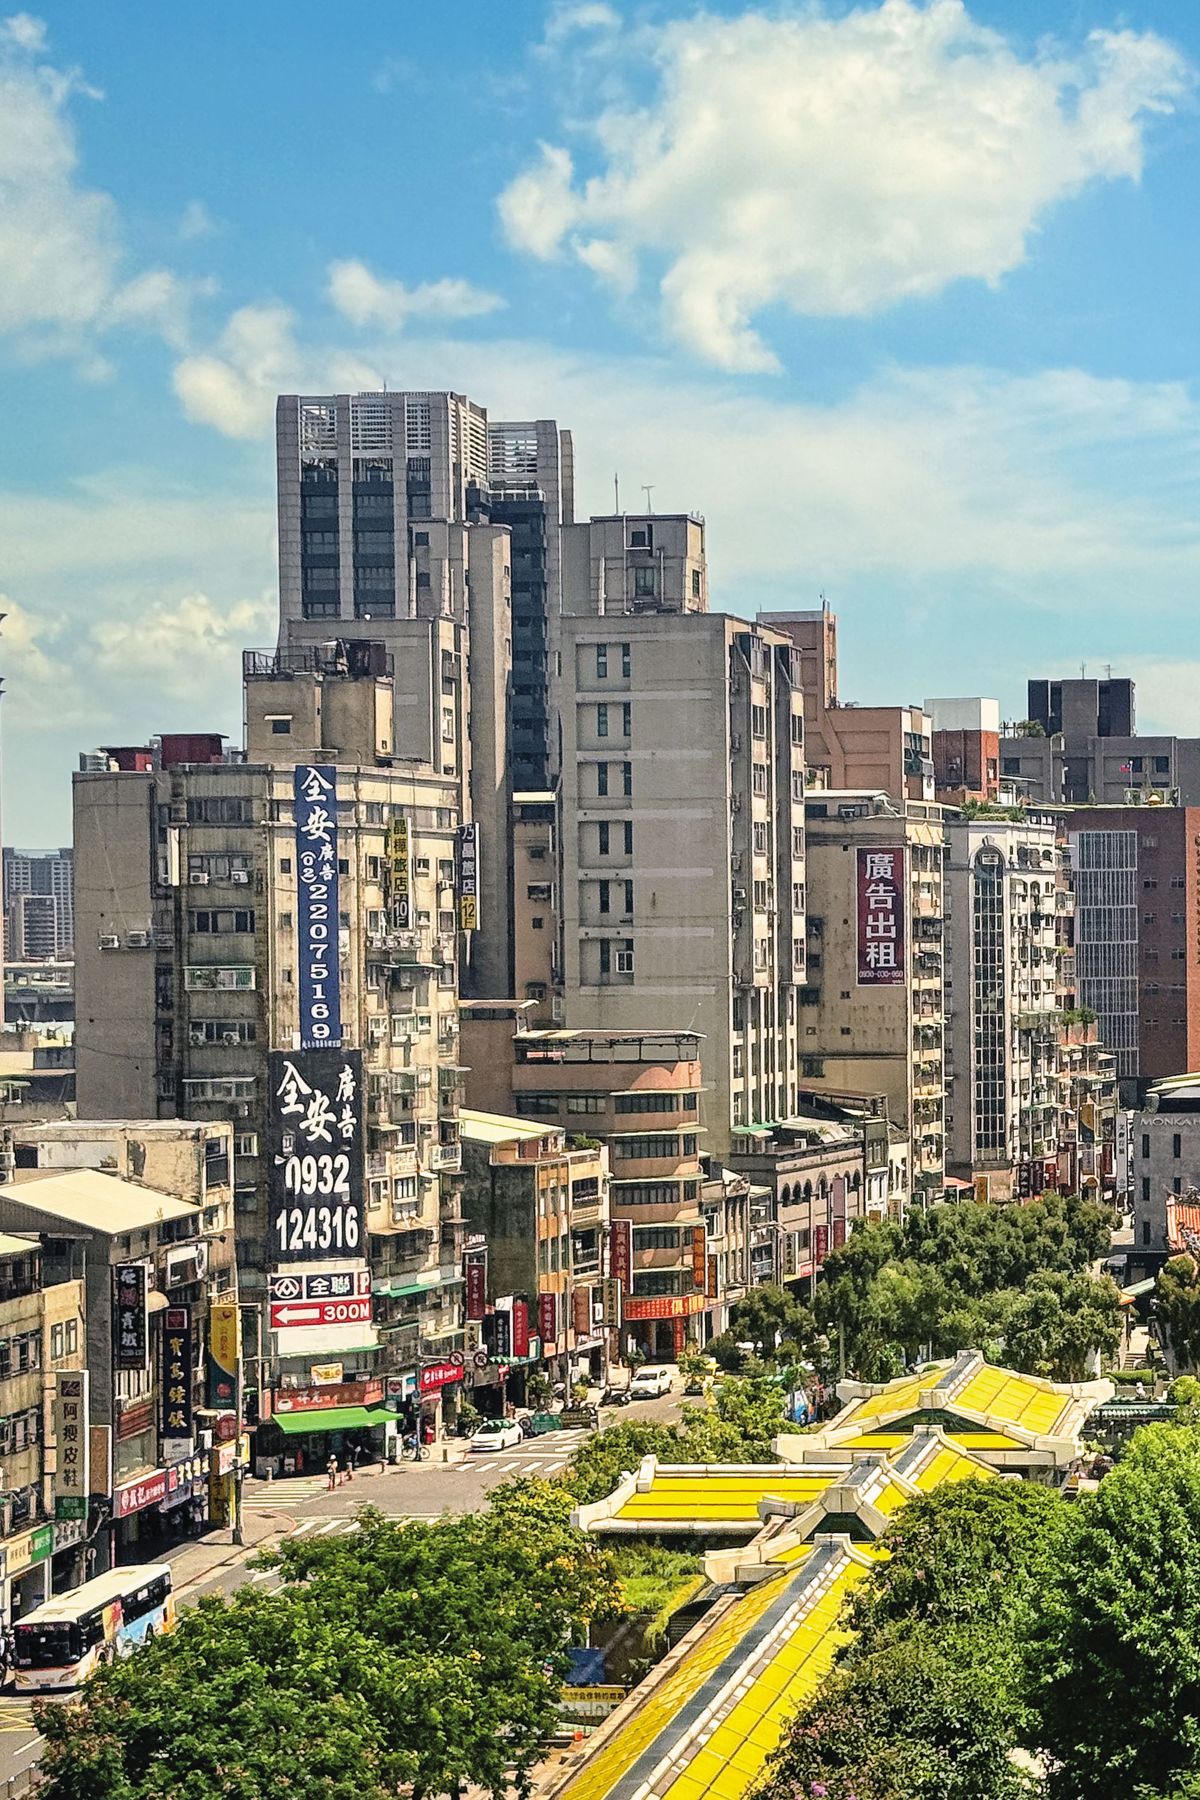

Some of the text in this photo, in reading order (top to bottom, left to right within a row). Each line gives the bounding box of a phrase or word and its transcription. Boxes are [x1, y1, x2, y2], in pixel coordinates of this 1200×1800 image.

[300, 767, 335, 841] 全安
[319, 843, 336, 881] 廣告
[865, 853, 897, 968] 廣告出租
[276, 1060, 337, 1143] 全安
[335, 1064, 357, 1140] 廣告
[1140, 1117, 1191, 1126] MONKA
[285, 1154, 350, 1195] 0932
[275, 1206, 359, 1251] 124316
[310, 1275, 350, 1297] 全聯
[323, 1303, 370, 1321] 300M
[62, 1402, 79, 1487] 阿瘦皮鞋
